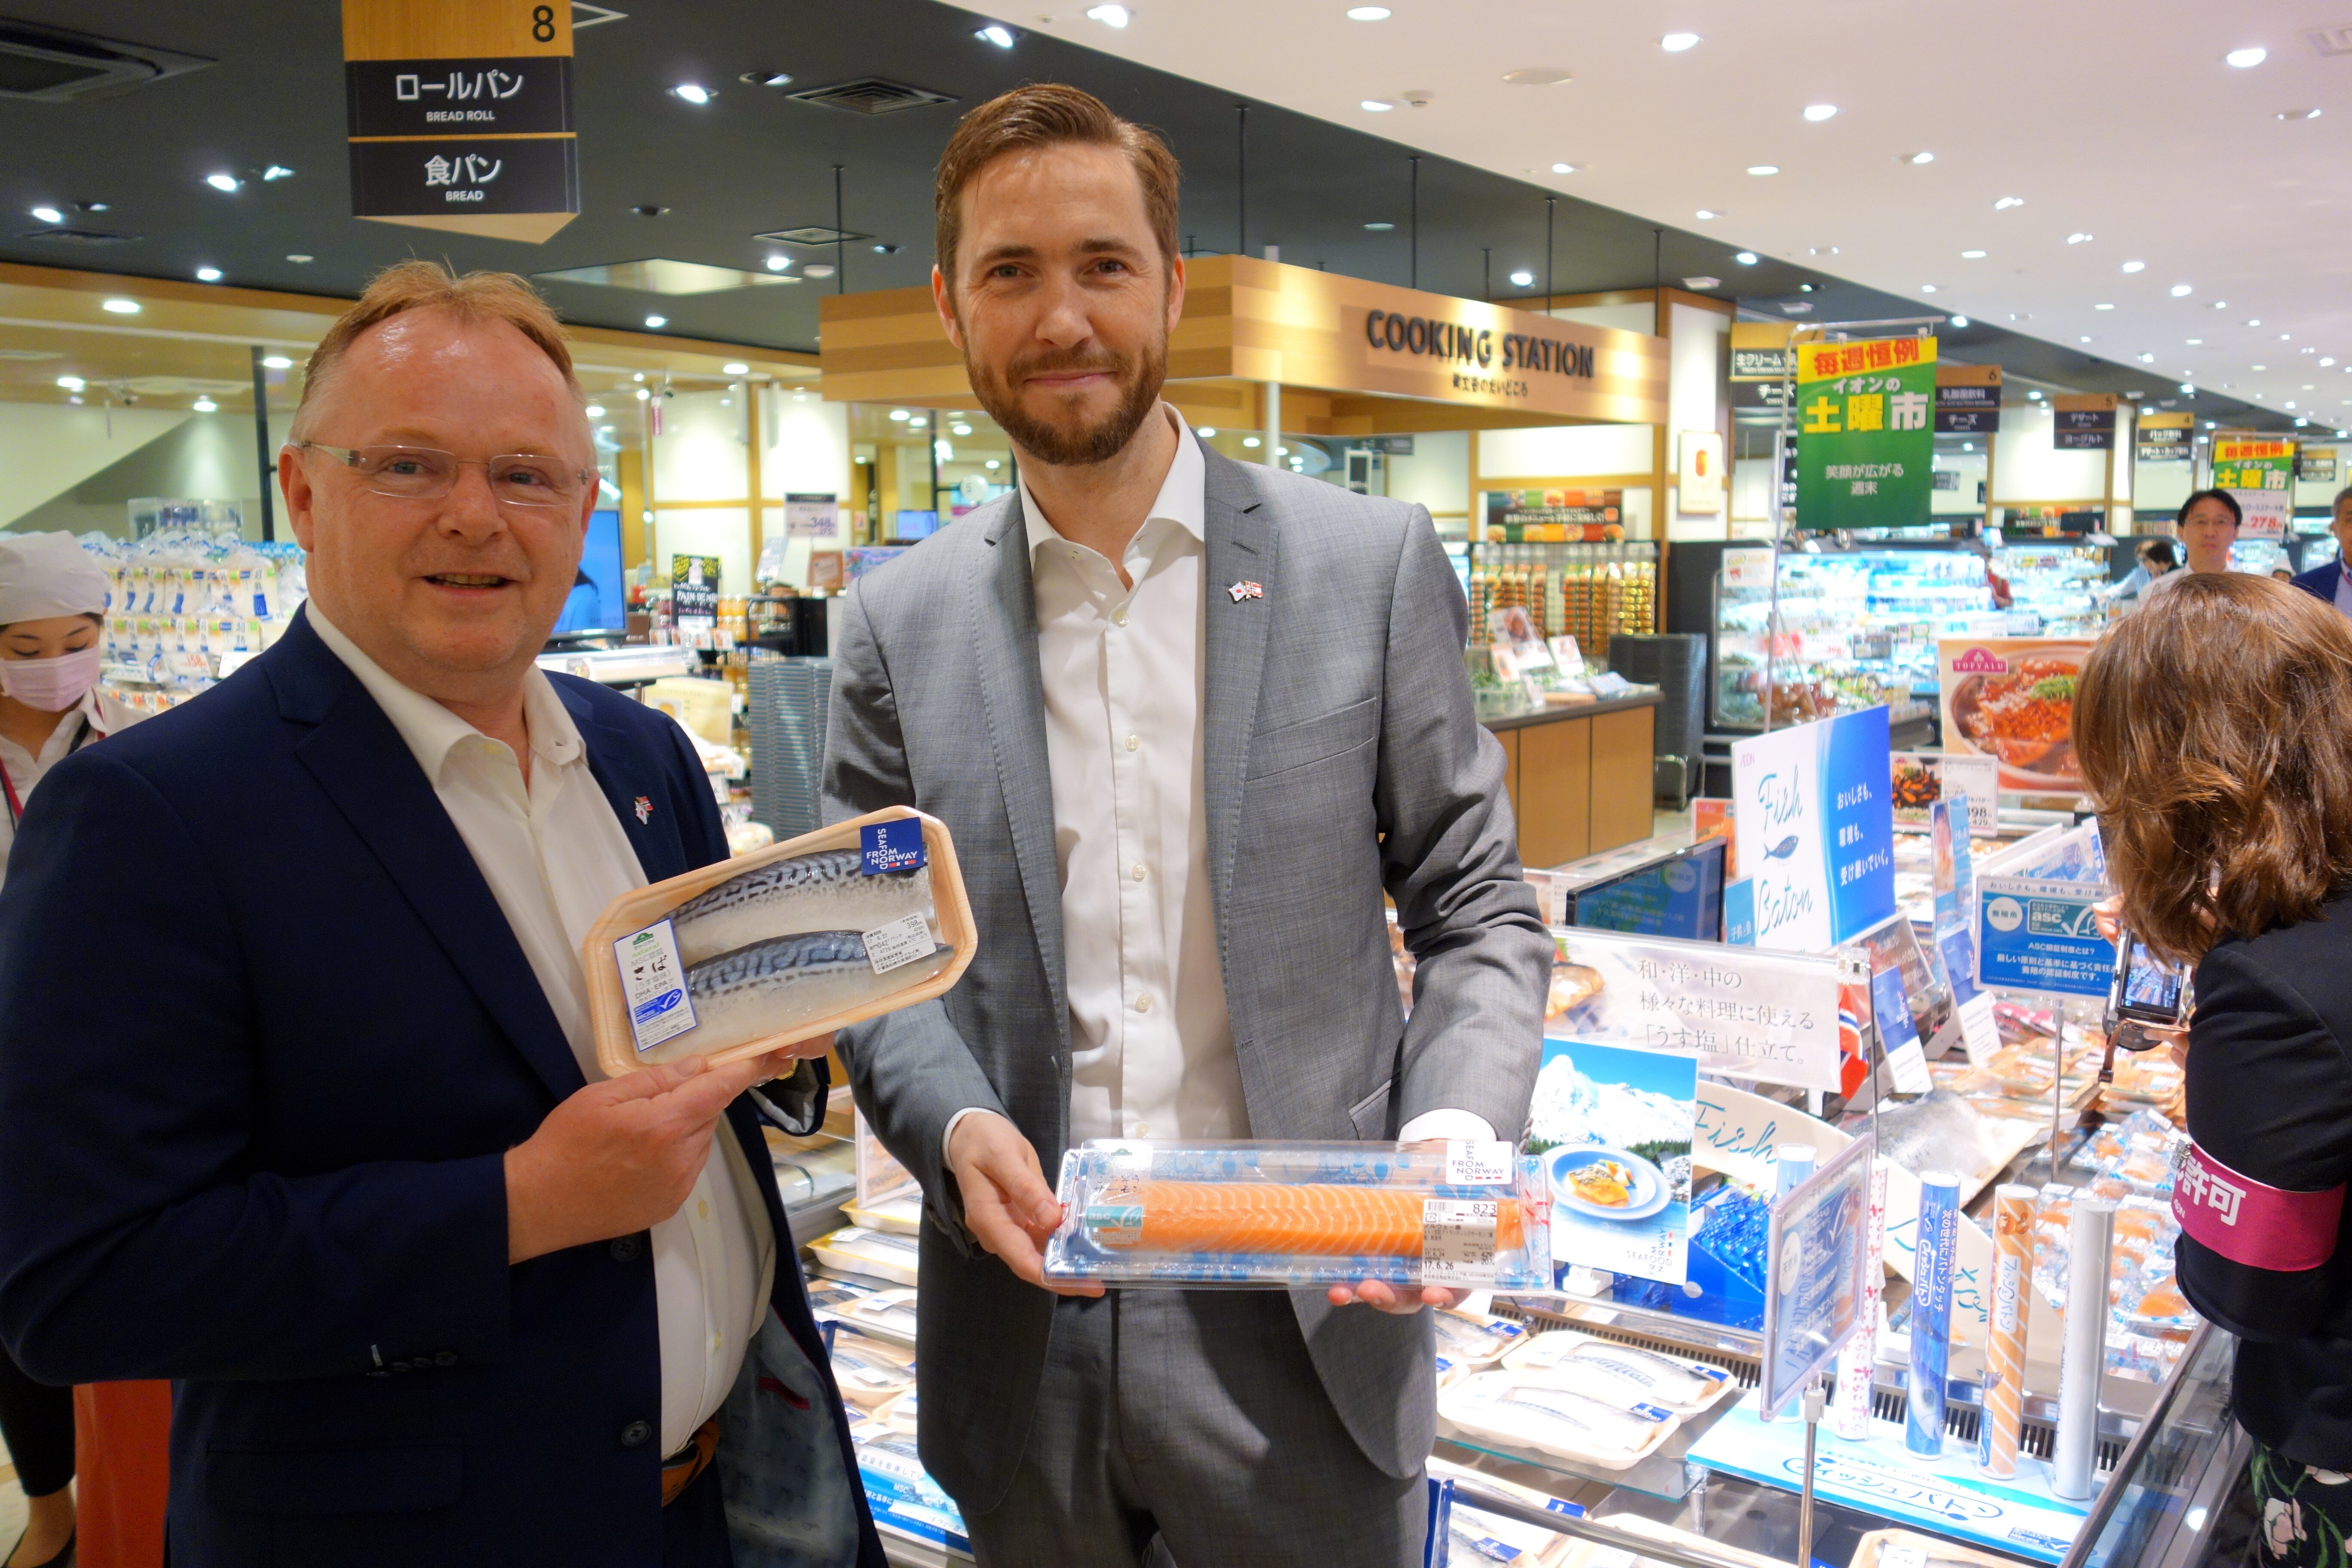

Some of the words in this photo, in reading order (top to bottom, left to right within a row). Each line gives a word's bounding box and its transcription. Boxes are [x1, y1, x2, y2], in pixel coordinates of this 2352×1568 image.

[533, 5, 555, 42] 8
[396, 69, 523, 100] ロールパン
[426, 111, 464, 122] BREAD
[466, 110, 495, 121] ROLL
[424, 154, 502, 186] 食パン
[446, 190, 483, 201] BREAD
[1367, 310, 1492, 364] COOKING
[1502, 332, 1594, 378] STATION
[1814, 338, 1920, 377] 毎週恒例
[1832, 377, 1901, 395] イオンの
[1804, 391, 1929, 434] 土曜市
[1825, 463, 1904, 480] 笑顔が広がる
[1851, 481, 1878, 496] 週末
[1758, 764, 1803, 833] Fish
[1837, 781, 1873, 810] おいしさも、
[877, 828, 888, 870] SEAFOOD
[1839, 823, 1864, 848] 環境も、
[866, 848, 897, 859] FROM
[871, 851, 918, 865] NORWAY
[1841, 848, 1889, 888] 受け継いでいく。
[1755, 873, 1813, 939] Baton
[2031, 911, 2062, 923] asc
[633, 954, 667, 980] さば
[1638, 960, 1742, 989] 和・洋・中の
[1639, 990, 1814, 1030] 様々な料理に使える
[1647, 1024, 1804, 1065] 「うす塩」仕立て。
[2177, 1156, 2247, 1226] 許可
[1473, 1203, 1497, 1215] 823
[1626, 1250, 1672, 1266] SEAFOOD
[1649, 1246, 1657, 1275] FROM
[1658, 1228, 1667, 1273] NORWAY
